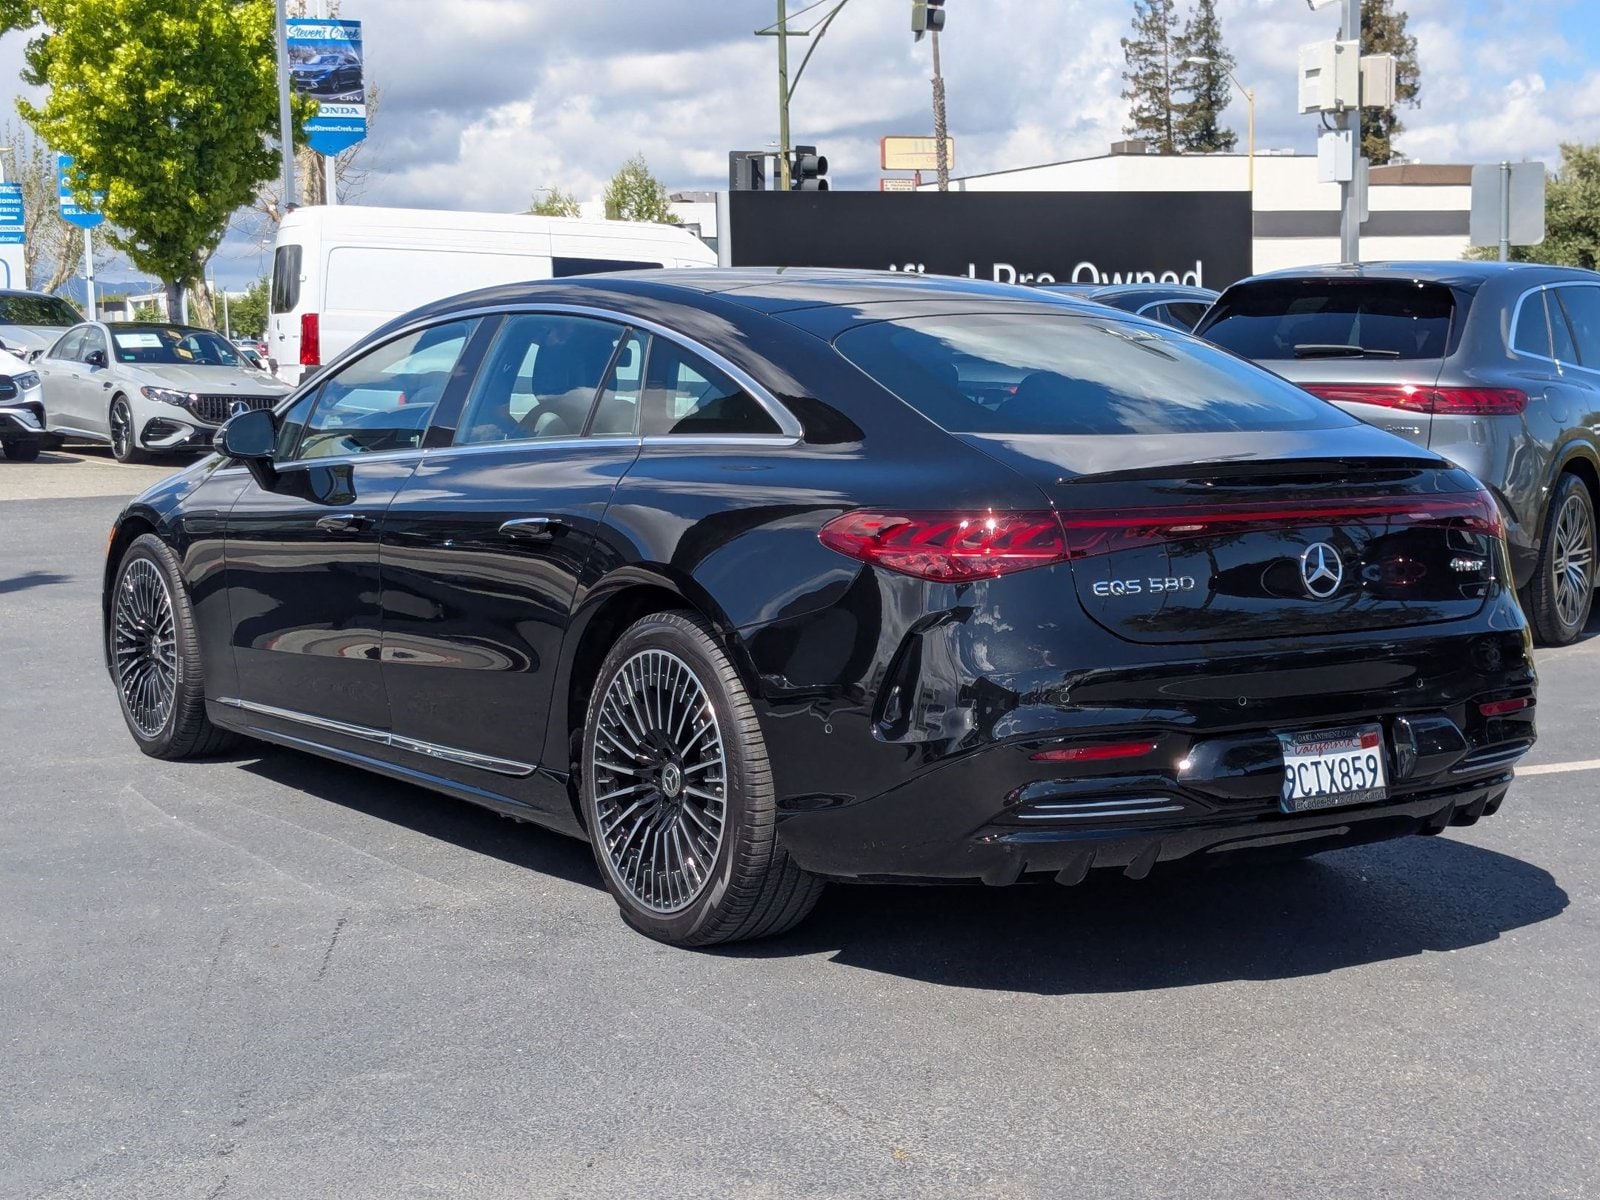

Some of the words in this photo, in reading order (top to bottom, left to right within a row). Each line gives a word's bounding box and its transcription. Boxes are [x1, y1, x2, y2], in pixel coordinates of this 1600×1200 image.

[329, 25, 360, 39] Creek
[319, 106, 359, 114] ONDA
[1093, 579, 1142, 596] EQS
[1148, 576, 1195, 592] 580
[1295, 738, 1361, 758] California
[1284, 754, 1379, 802] 9CIX859
[1296, 794, 1343, 811] ercedes-Benz
